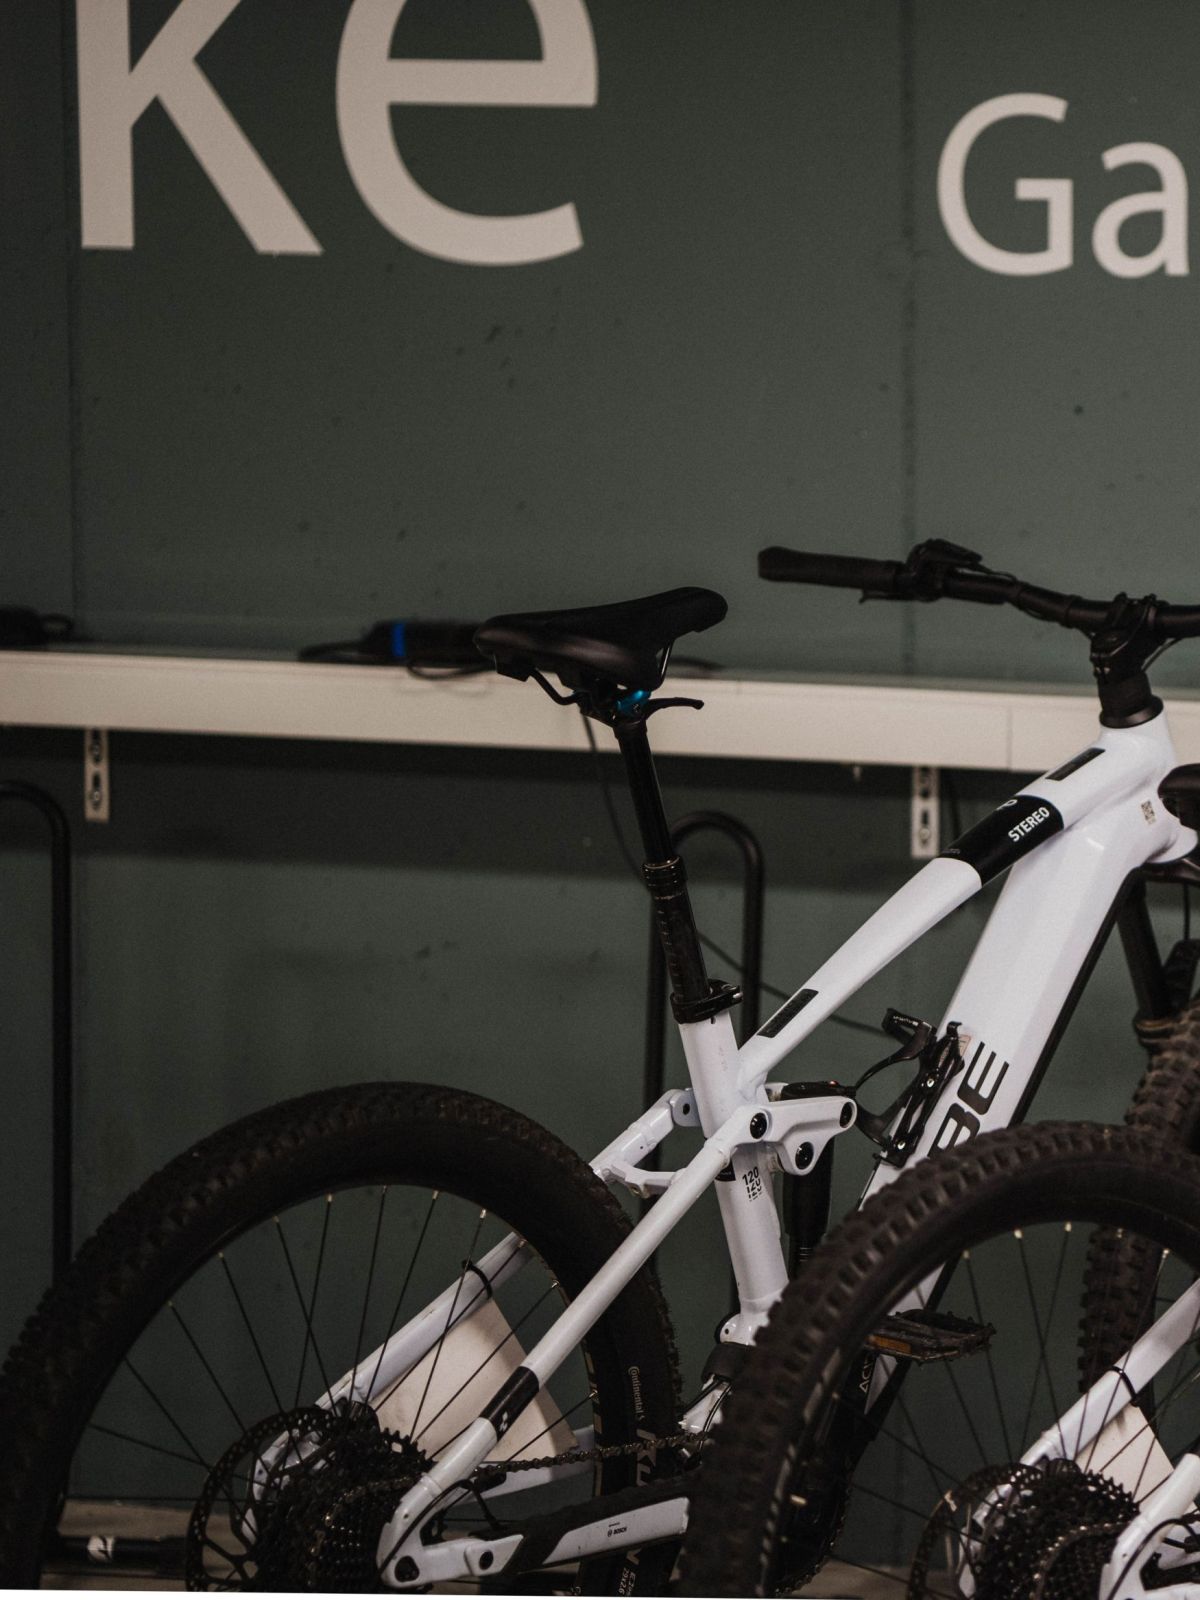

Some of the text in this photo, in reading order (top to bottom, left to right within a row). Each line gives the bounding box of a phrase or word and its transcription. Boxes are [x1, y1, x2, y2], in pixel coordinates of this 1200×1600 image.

[1008, 806, 1050, 843] STEREO
[928, 1041, 1009, 1157] BE
[628, 1365, 645, 1414] Continental
